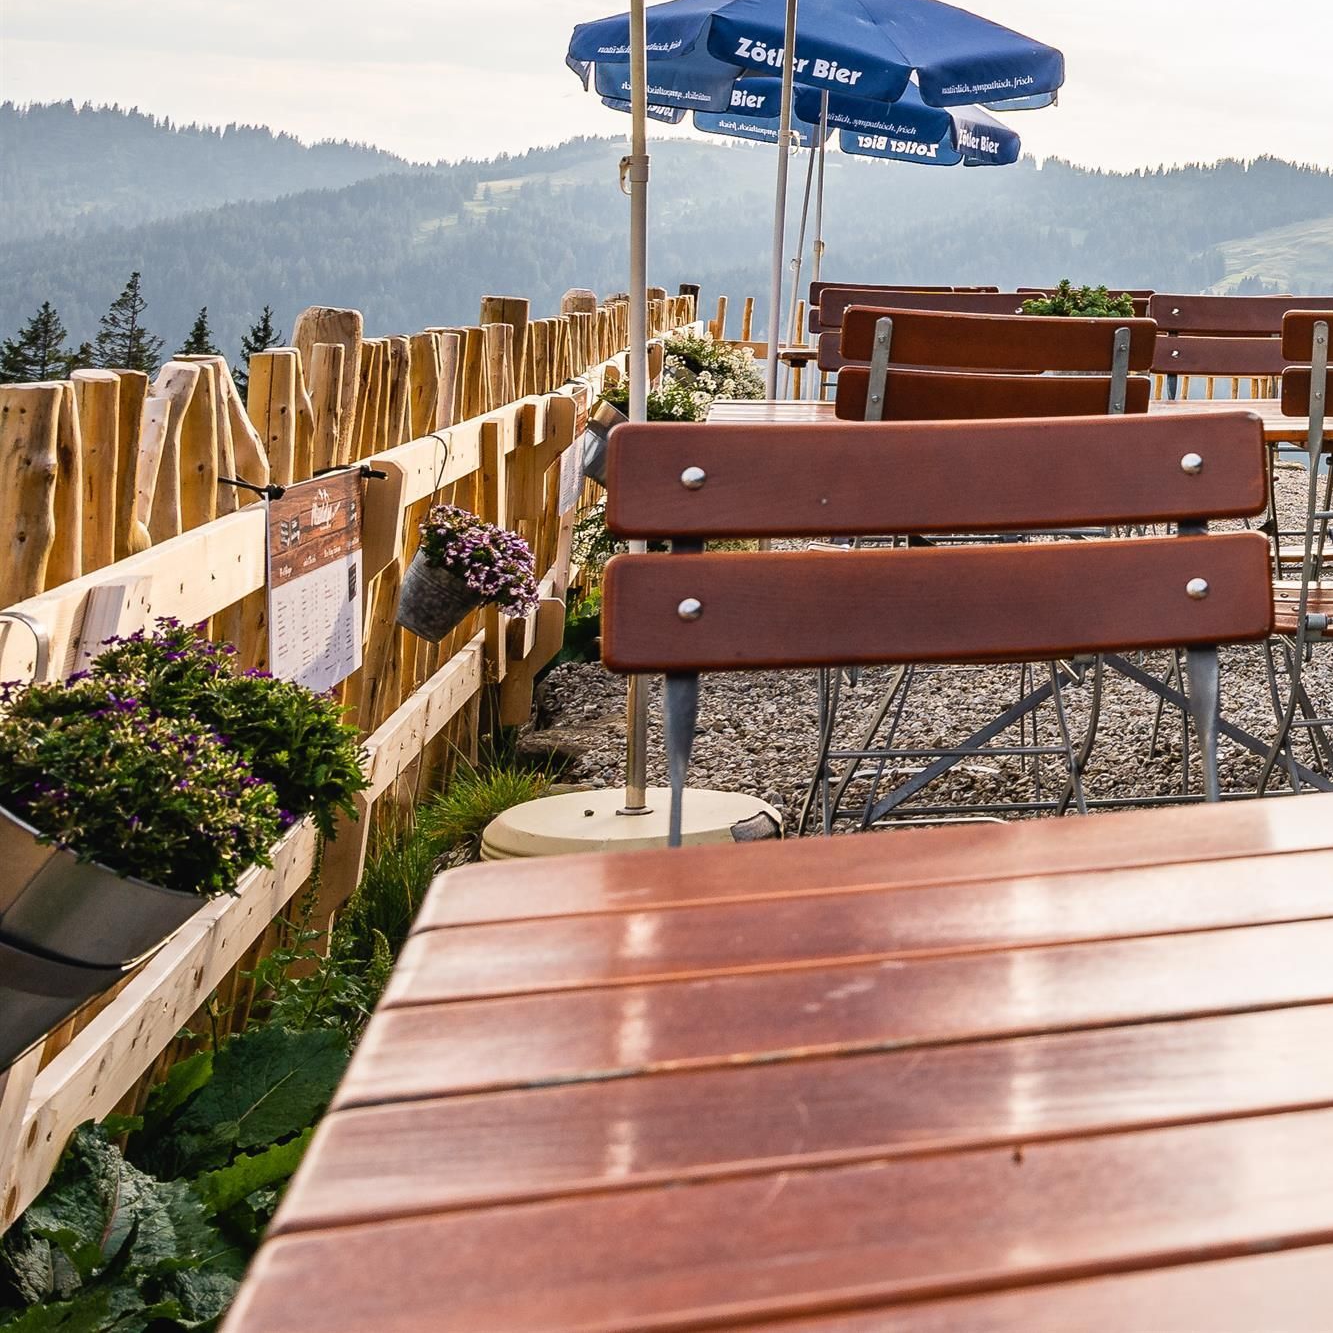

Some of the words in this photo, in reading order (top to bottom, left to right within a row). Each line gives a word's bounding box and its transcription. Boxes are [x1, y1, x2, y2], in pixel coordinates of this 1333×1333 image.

[812, 58, 863, 85] Bier
[1014, 75, 1034, 88] frisch
[730, 89, 766, 109] Bier
[818, 112, 852, 124] türlich,
[958, 128, 979, 150] Zötler
[980, 135, 1000, 154] Bier
